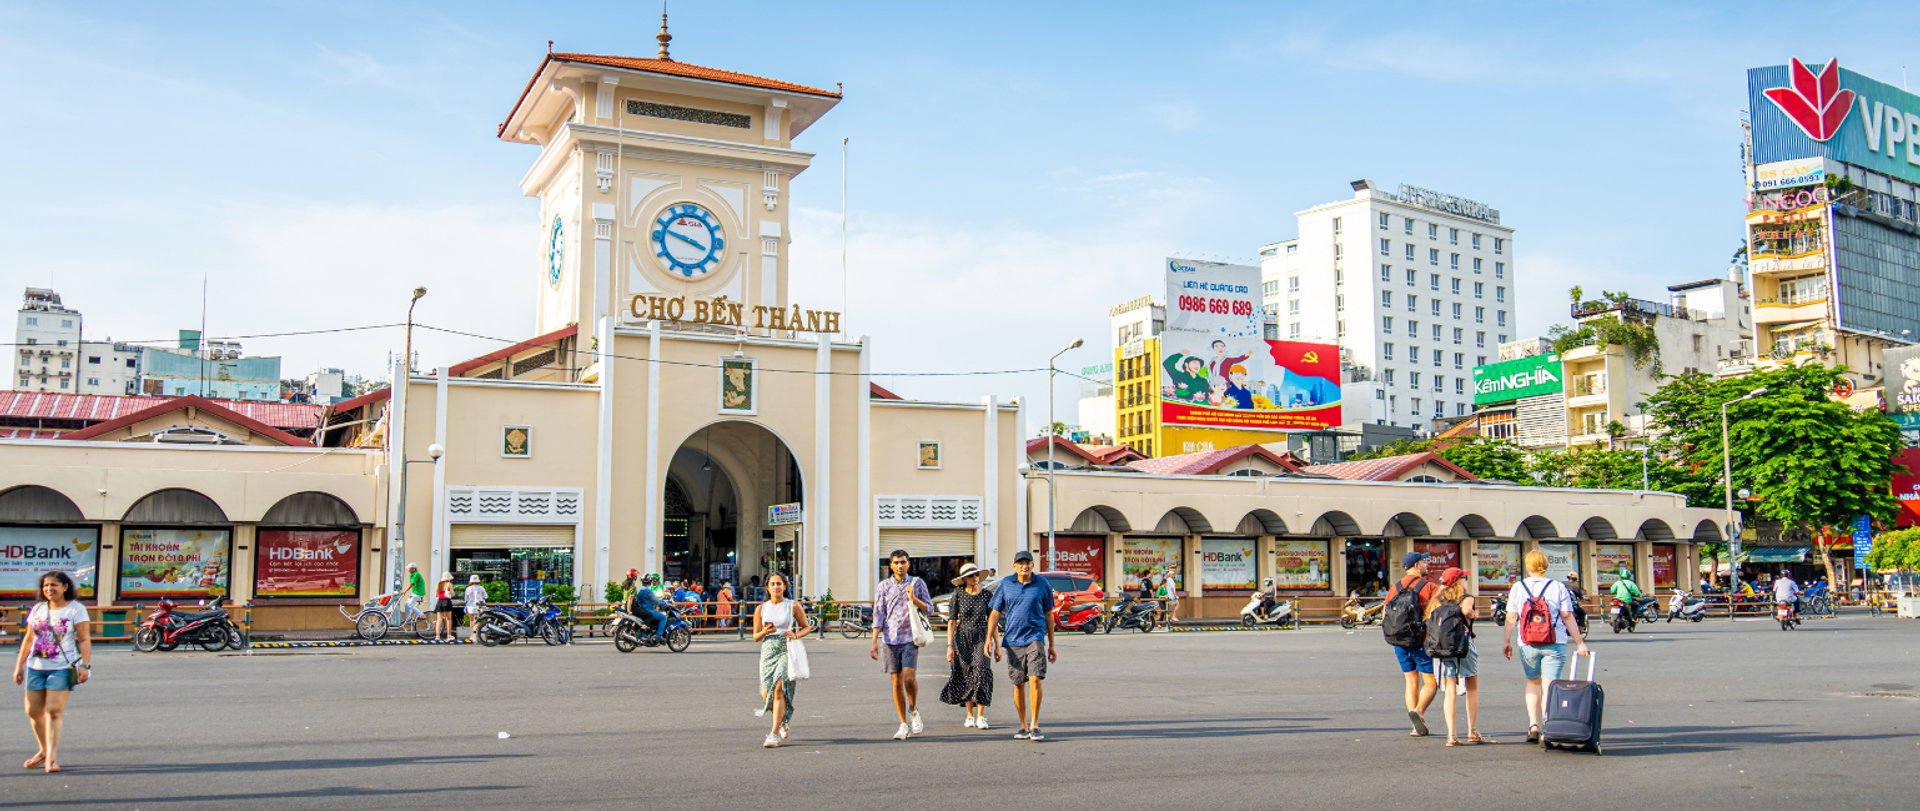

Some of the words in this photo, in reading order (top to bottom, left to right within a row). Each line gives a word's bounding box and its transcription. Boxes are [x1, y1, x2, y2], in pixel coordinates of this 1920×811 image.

[1760, 169, 1777, 180] BS
[1179, 294, 1206, 313] 0986
[1209, 298, 1229, 315] 669
[1232, 299, 1252, 316] 689
[630, 294, 685, 324] CHỢ
[694, 294, 744, 326] BẾN
[752, 303, 841, 333] THÀNH
[269, 547, 333, 560] HDBank
[1203, 552, 1242, 562] HDBank
[1546, 554, 1568, 564] Bank
